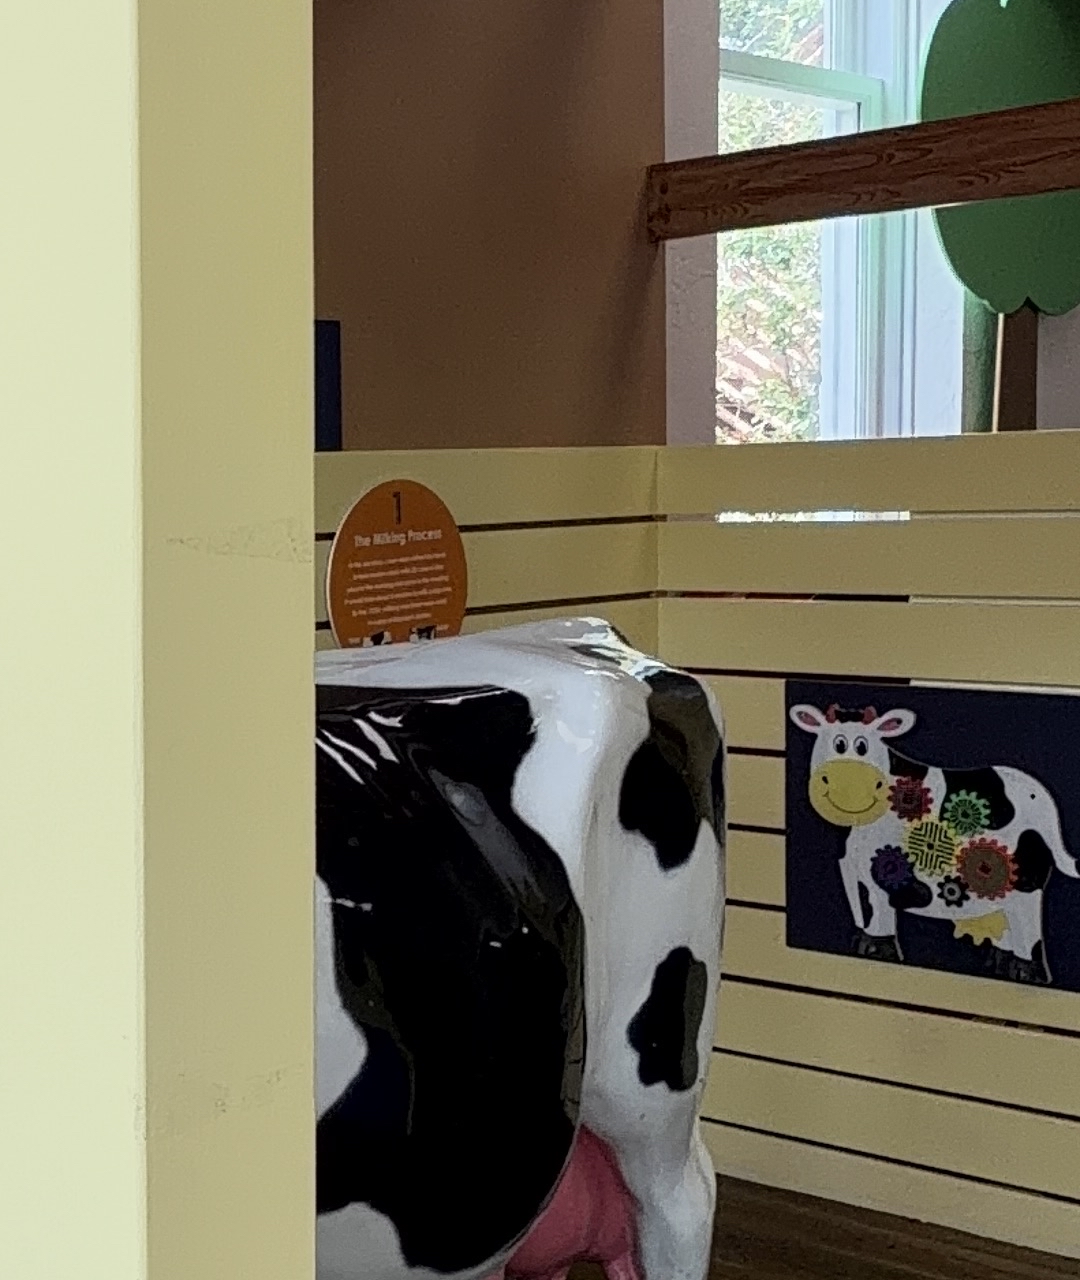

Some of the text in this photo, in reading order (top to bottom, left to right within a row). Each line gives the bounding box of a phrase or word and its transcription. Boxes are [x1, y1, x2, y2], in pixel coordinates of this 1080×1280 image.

[392, 491, 402, 525] 1
[354, 528, 442, 548] The Milking Process
